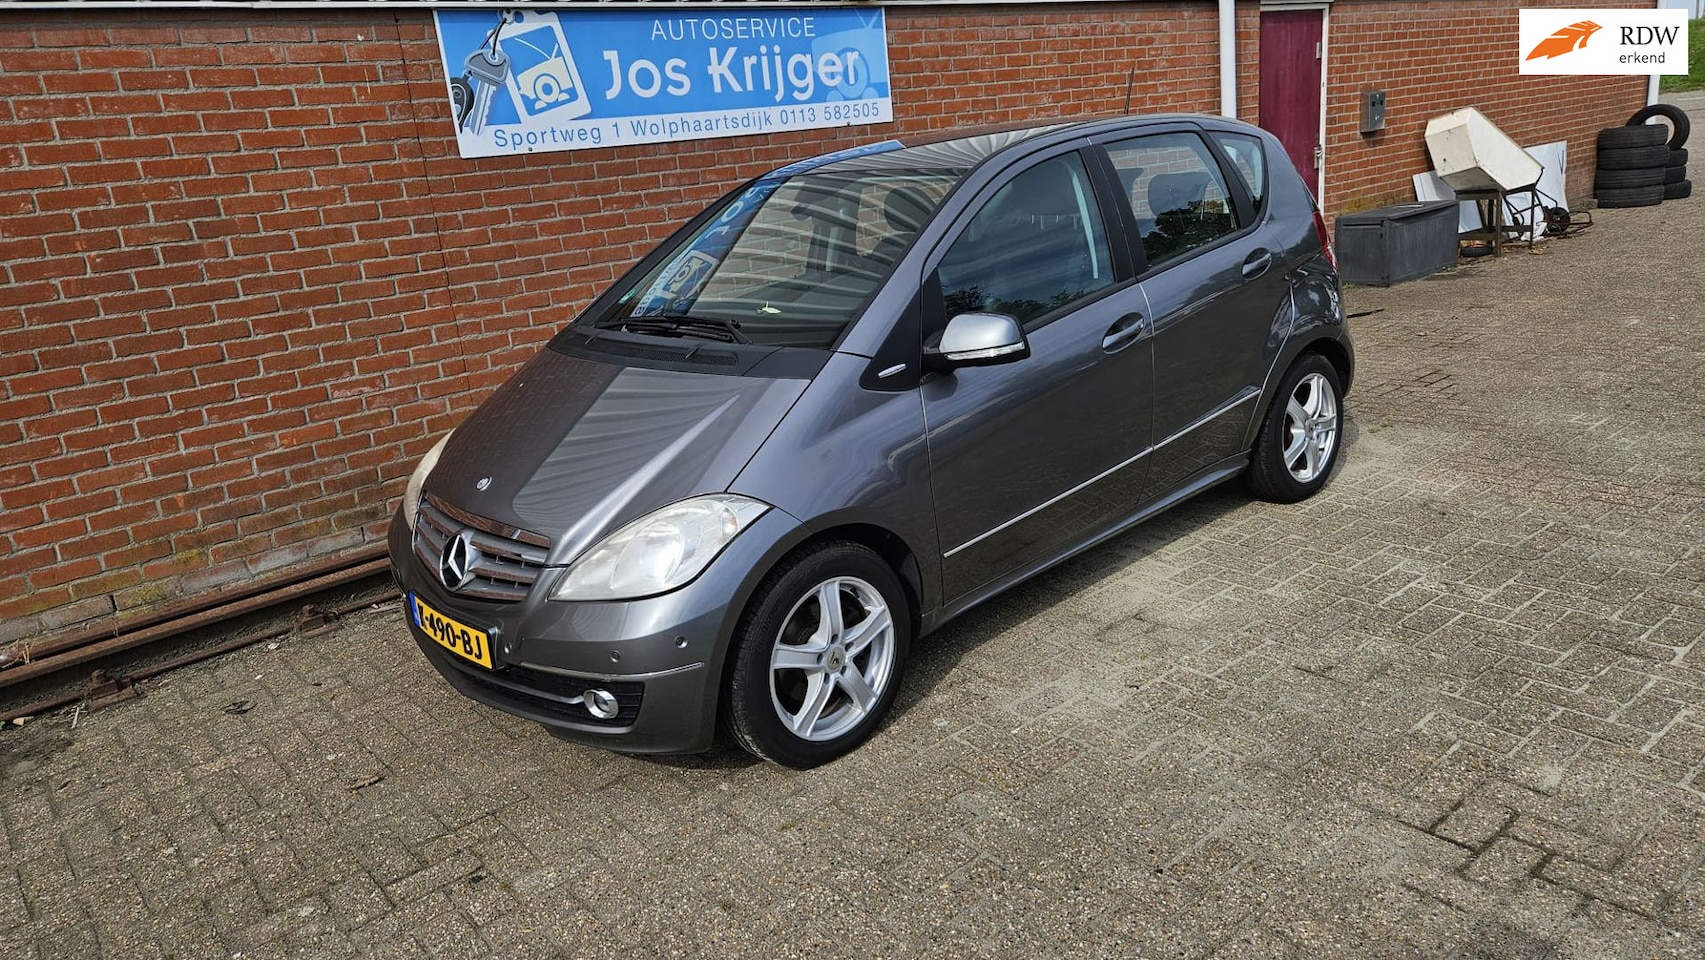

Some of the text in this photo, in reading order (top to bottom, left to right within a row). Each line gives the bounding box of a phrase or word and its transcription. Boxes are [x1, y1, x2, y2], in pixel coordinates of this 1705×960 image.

[651, 17, 816, 41] AUTOSERVICE
[603, 44, 860, 102] Jos Krijger
[494, 102, 880, 150] Sportweg 1 Wolphaartsdijk 0113 582505
